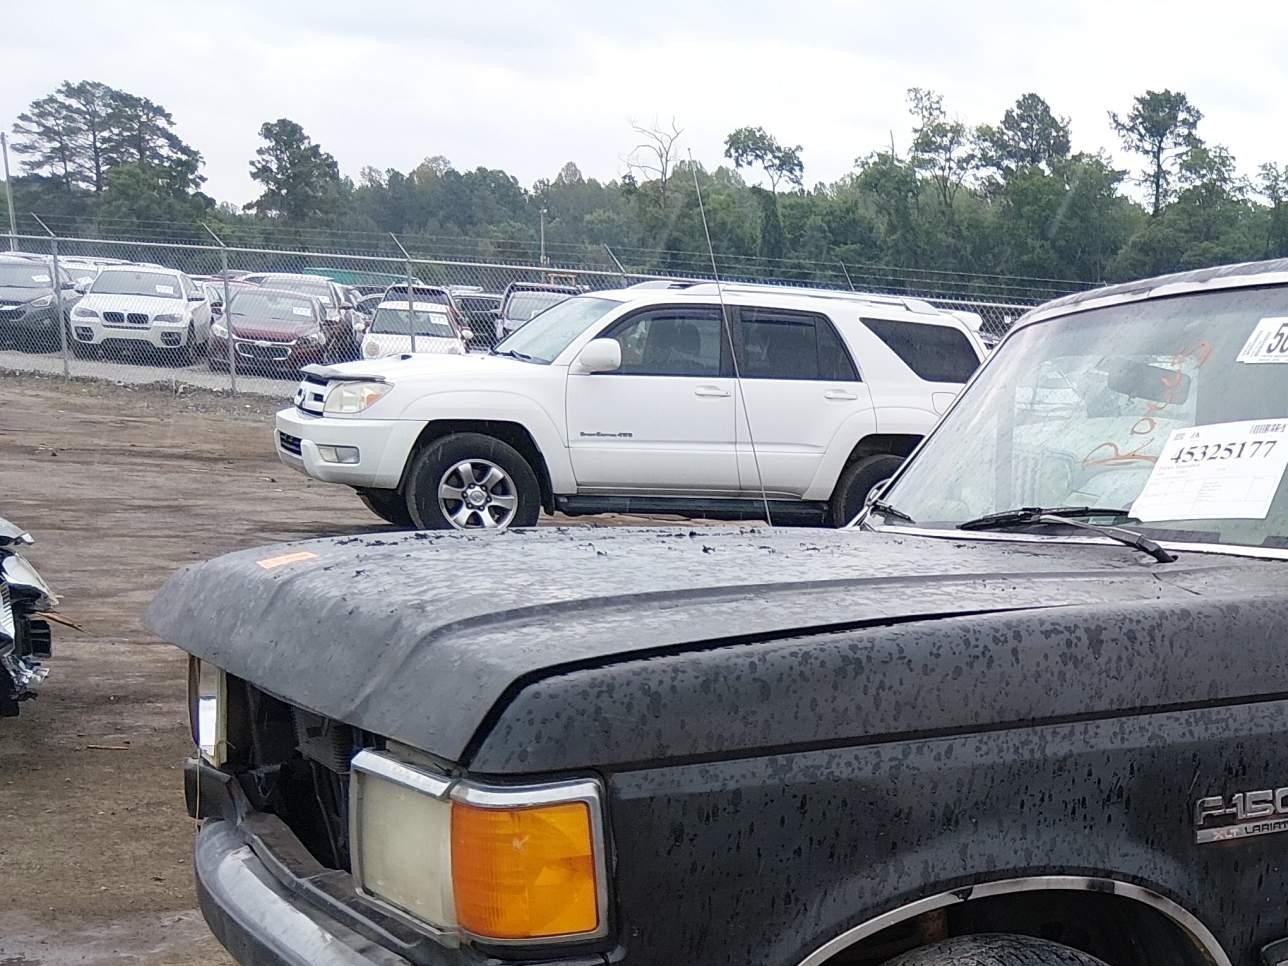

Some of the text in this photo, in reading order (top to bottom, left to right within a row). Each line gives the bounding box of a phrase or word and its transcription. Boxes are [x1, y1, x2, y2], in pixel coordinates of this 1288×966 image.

[1170, 439, 1278, 464] 45325177
[1213, 820, 1288, 841] XLT LARIAT
